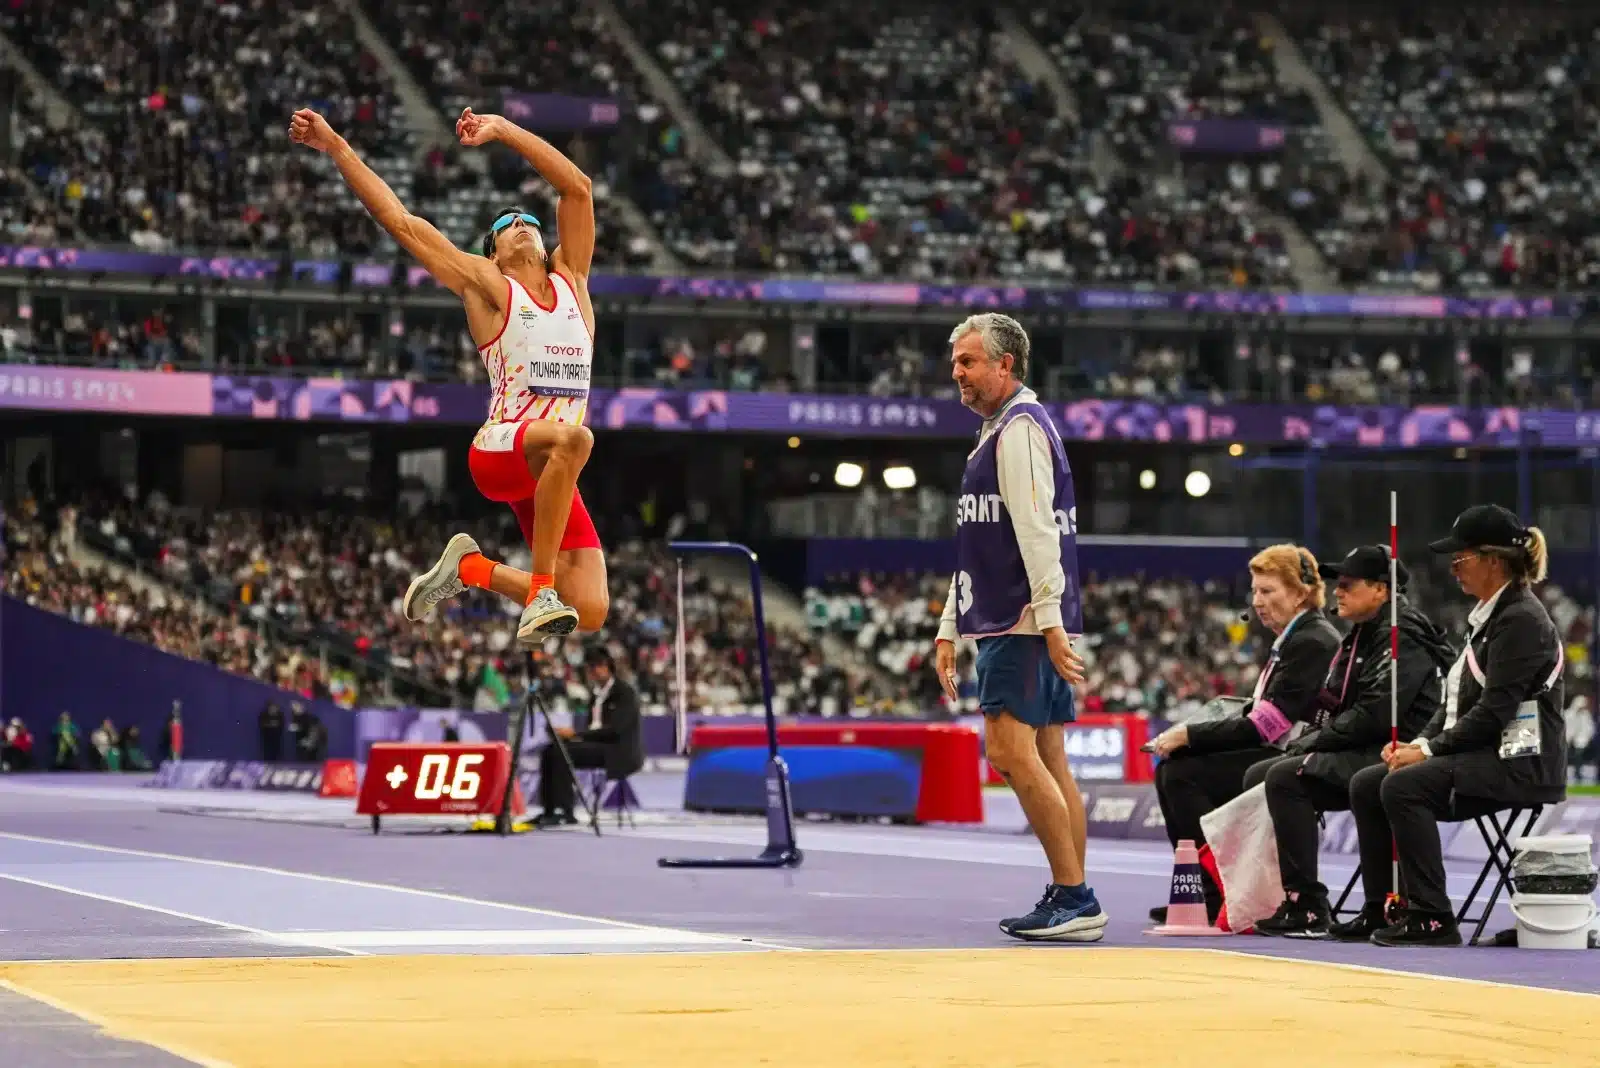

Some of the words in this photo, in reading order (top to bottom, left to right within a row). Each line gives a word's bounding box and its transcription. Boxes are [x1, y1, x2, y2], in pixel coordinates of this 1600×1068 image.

[530, 361, 560, 379] MUNAR
[414, 753, 485, 799] 0.6
[1173, 874, 1201, 884] PARIS
[1173, 884, 1203, 895] 2024
